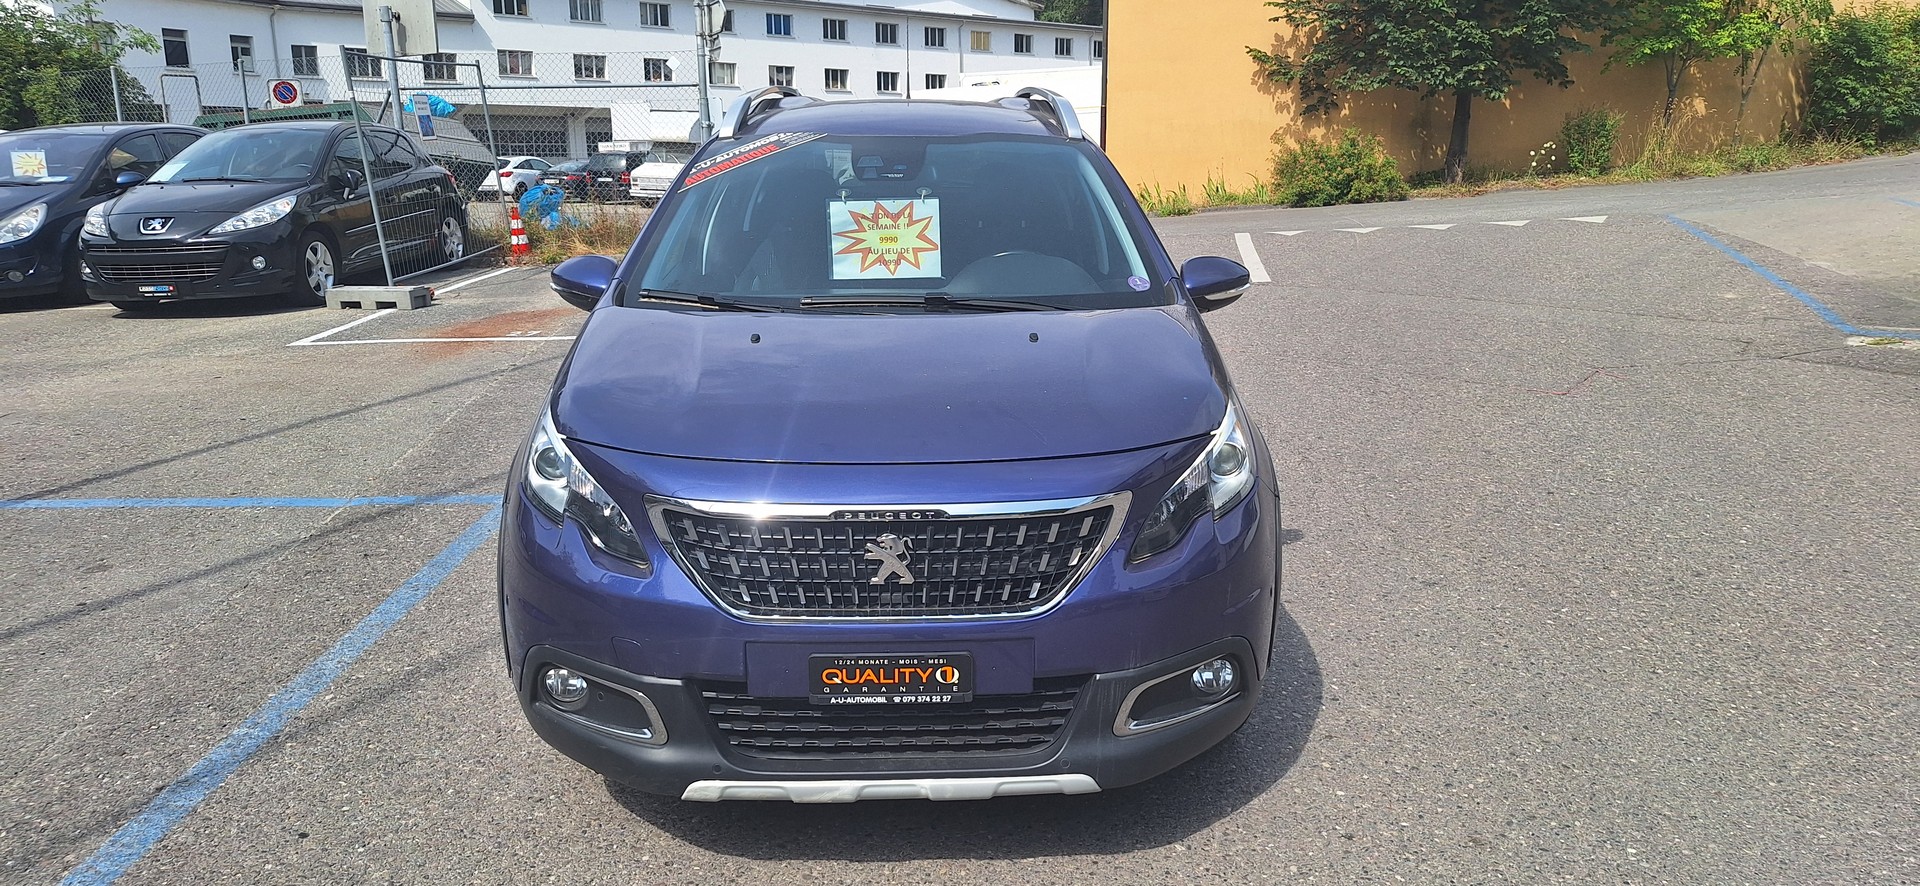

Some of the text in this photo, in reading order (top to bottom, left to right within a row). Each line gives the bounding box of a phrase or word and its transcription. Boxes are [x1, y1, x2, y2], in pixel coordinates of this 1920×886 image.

[684, 143, 780, 186] AUTOMATIQUE
[844, 512, 935, 520] PEUGEOT
[821, 667, 933, 684] QUALITY
[823, 685, 958, 693] GARANTIE
[830, 696, 887, 704] A-U-AUTOMOBIL
